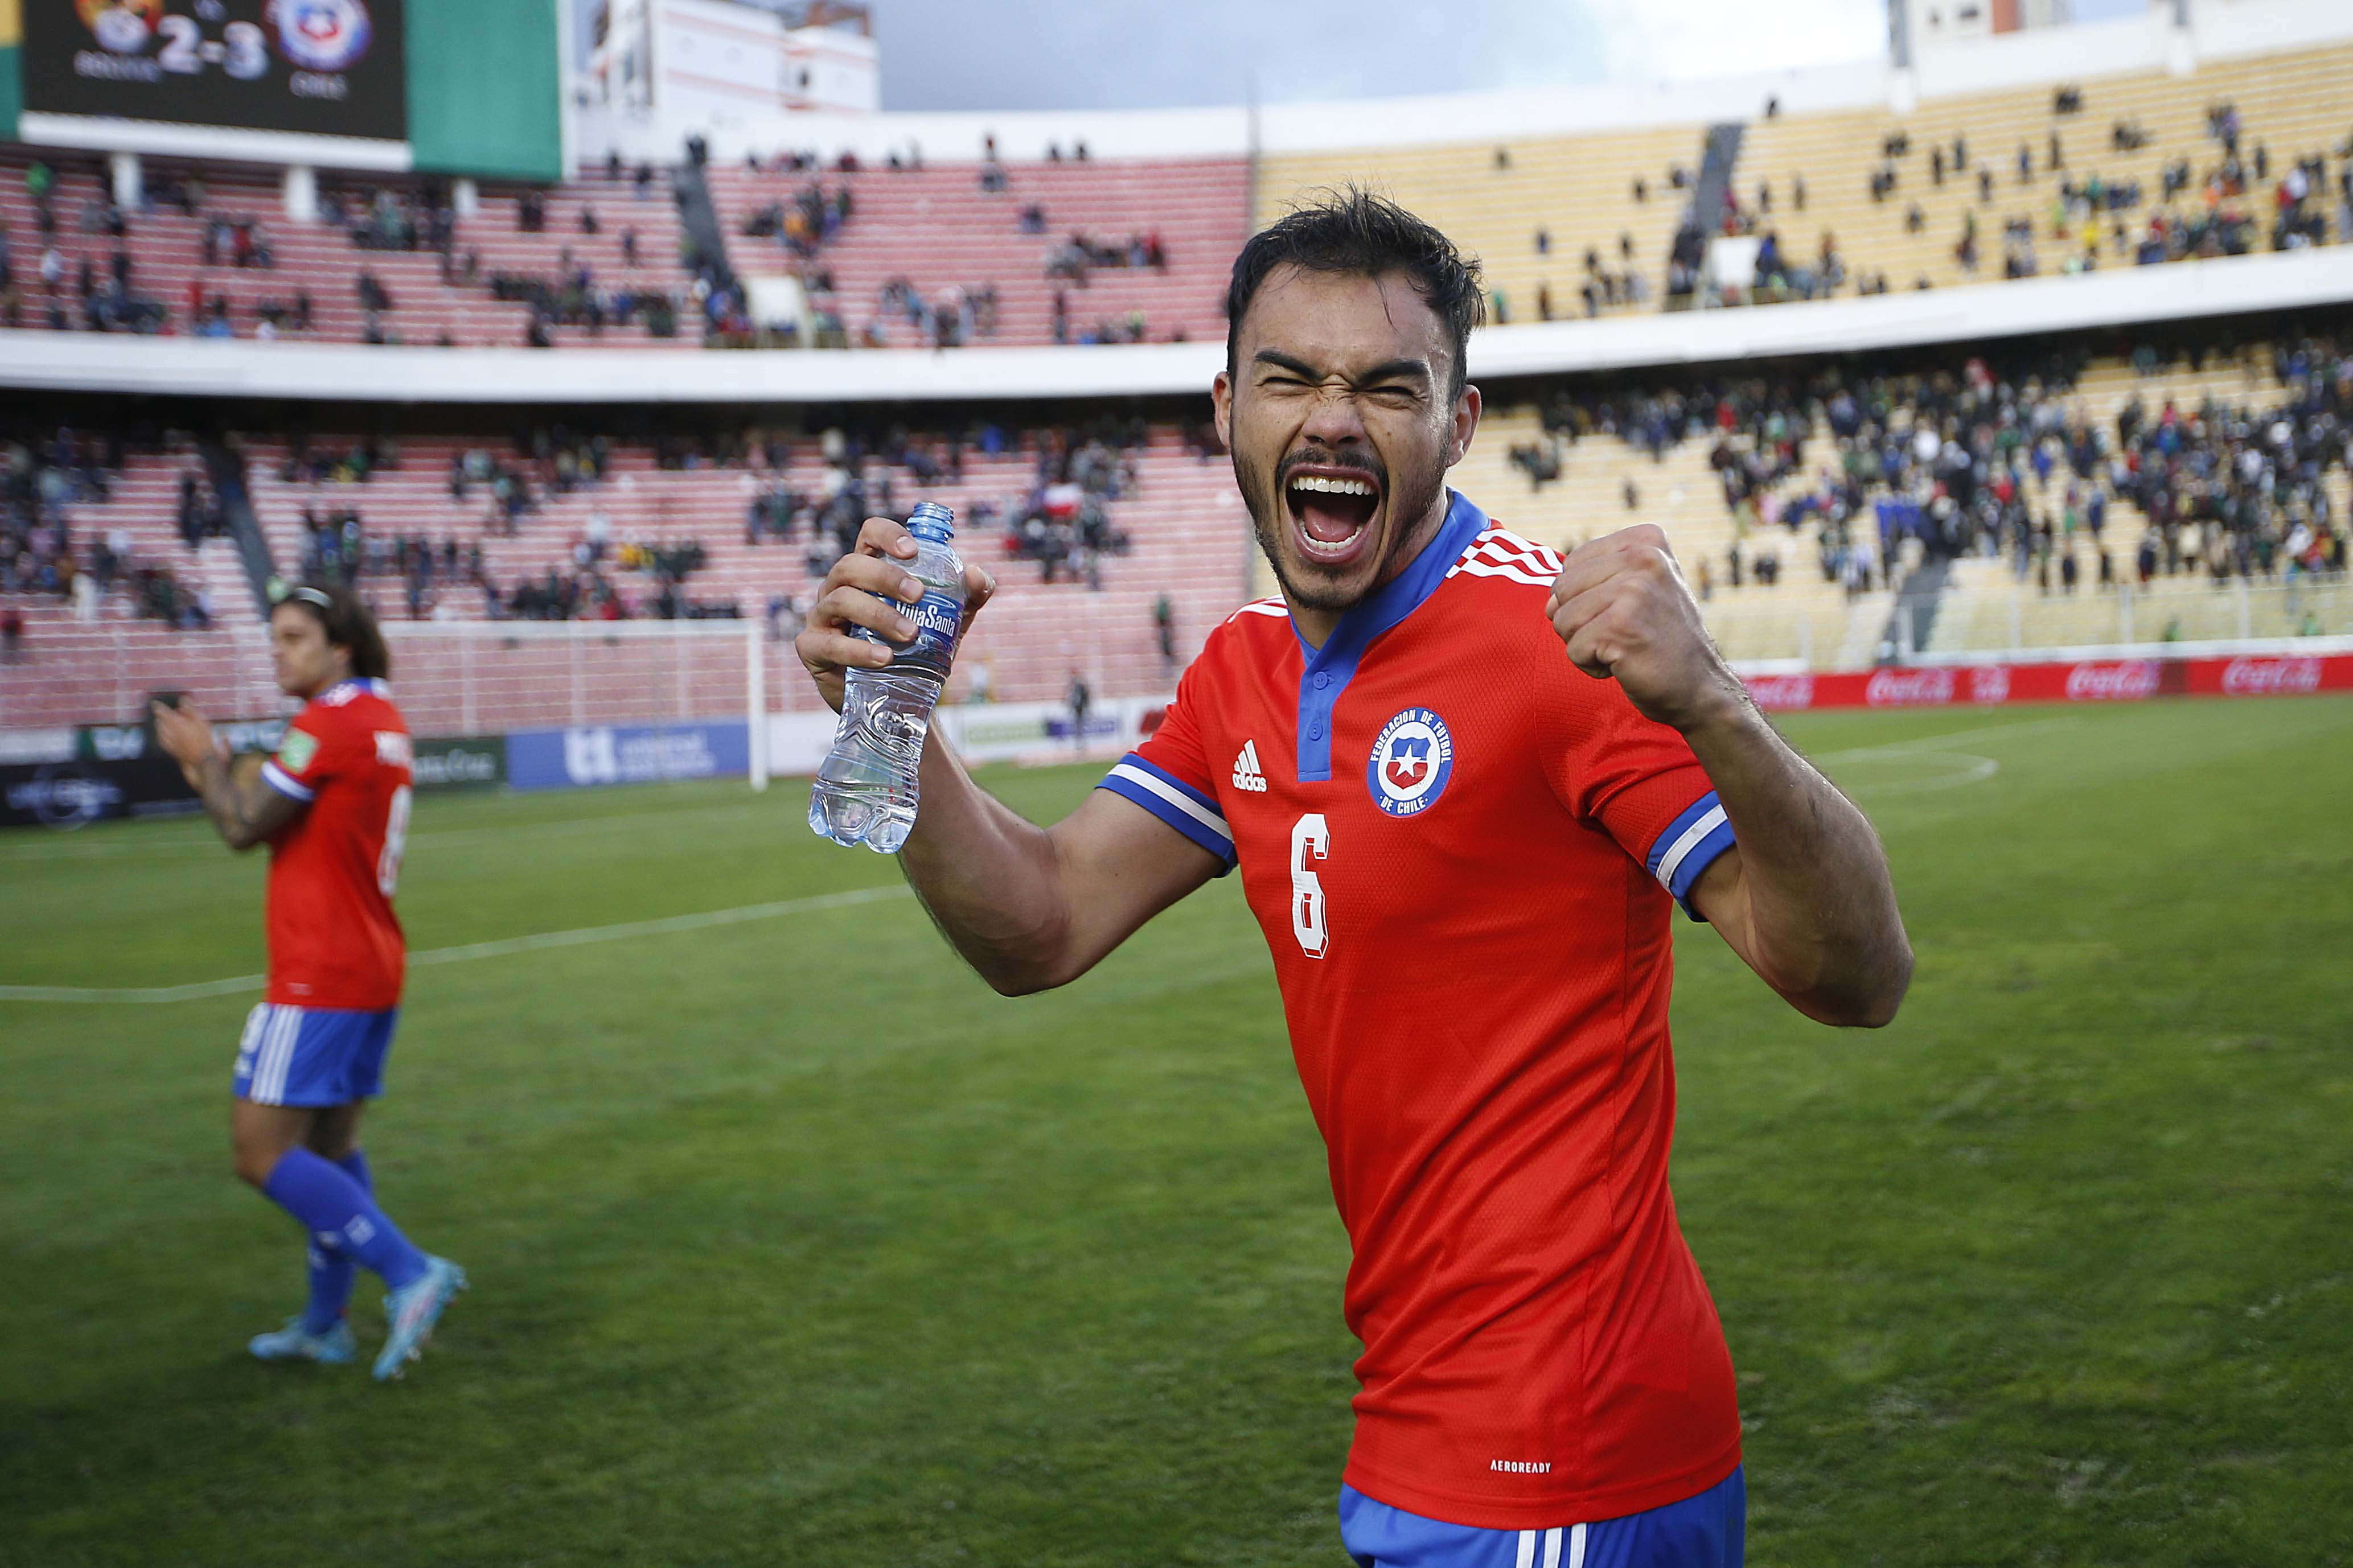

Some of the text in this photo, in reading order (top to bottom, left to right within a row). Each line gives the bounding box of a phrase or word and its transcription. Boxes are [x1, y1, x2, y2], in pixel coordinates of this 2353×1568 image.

[1370, 709, 1451, 764] FEDERACION DE FUTBOL
[1232, 773, 1267, 792] adidas
[1380, 796, 1426, 814] DE CHILE
[1291, 813, 1330, 960] 6
[1490, 1459, 1551, 1474] AEROREADY
